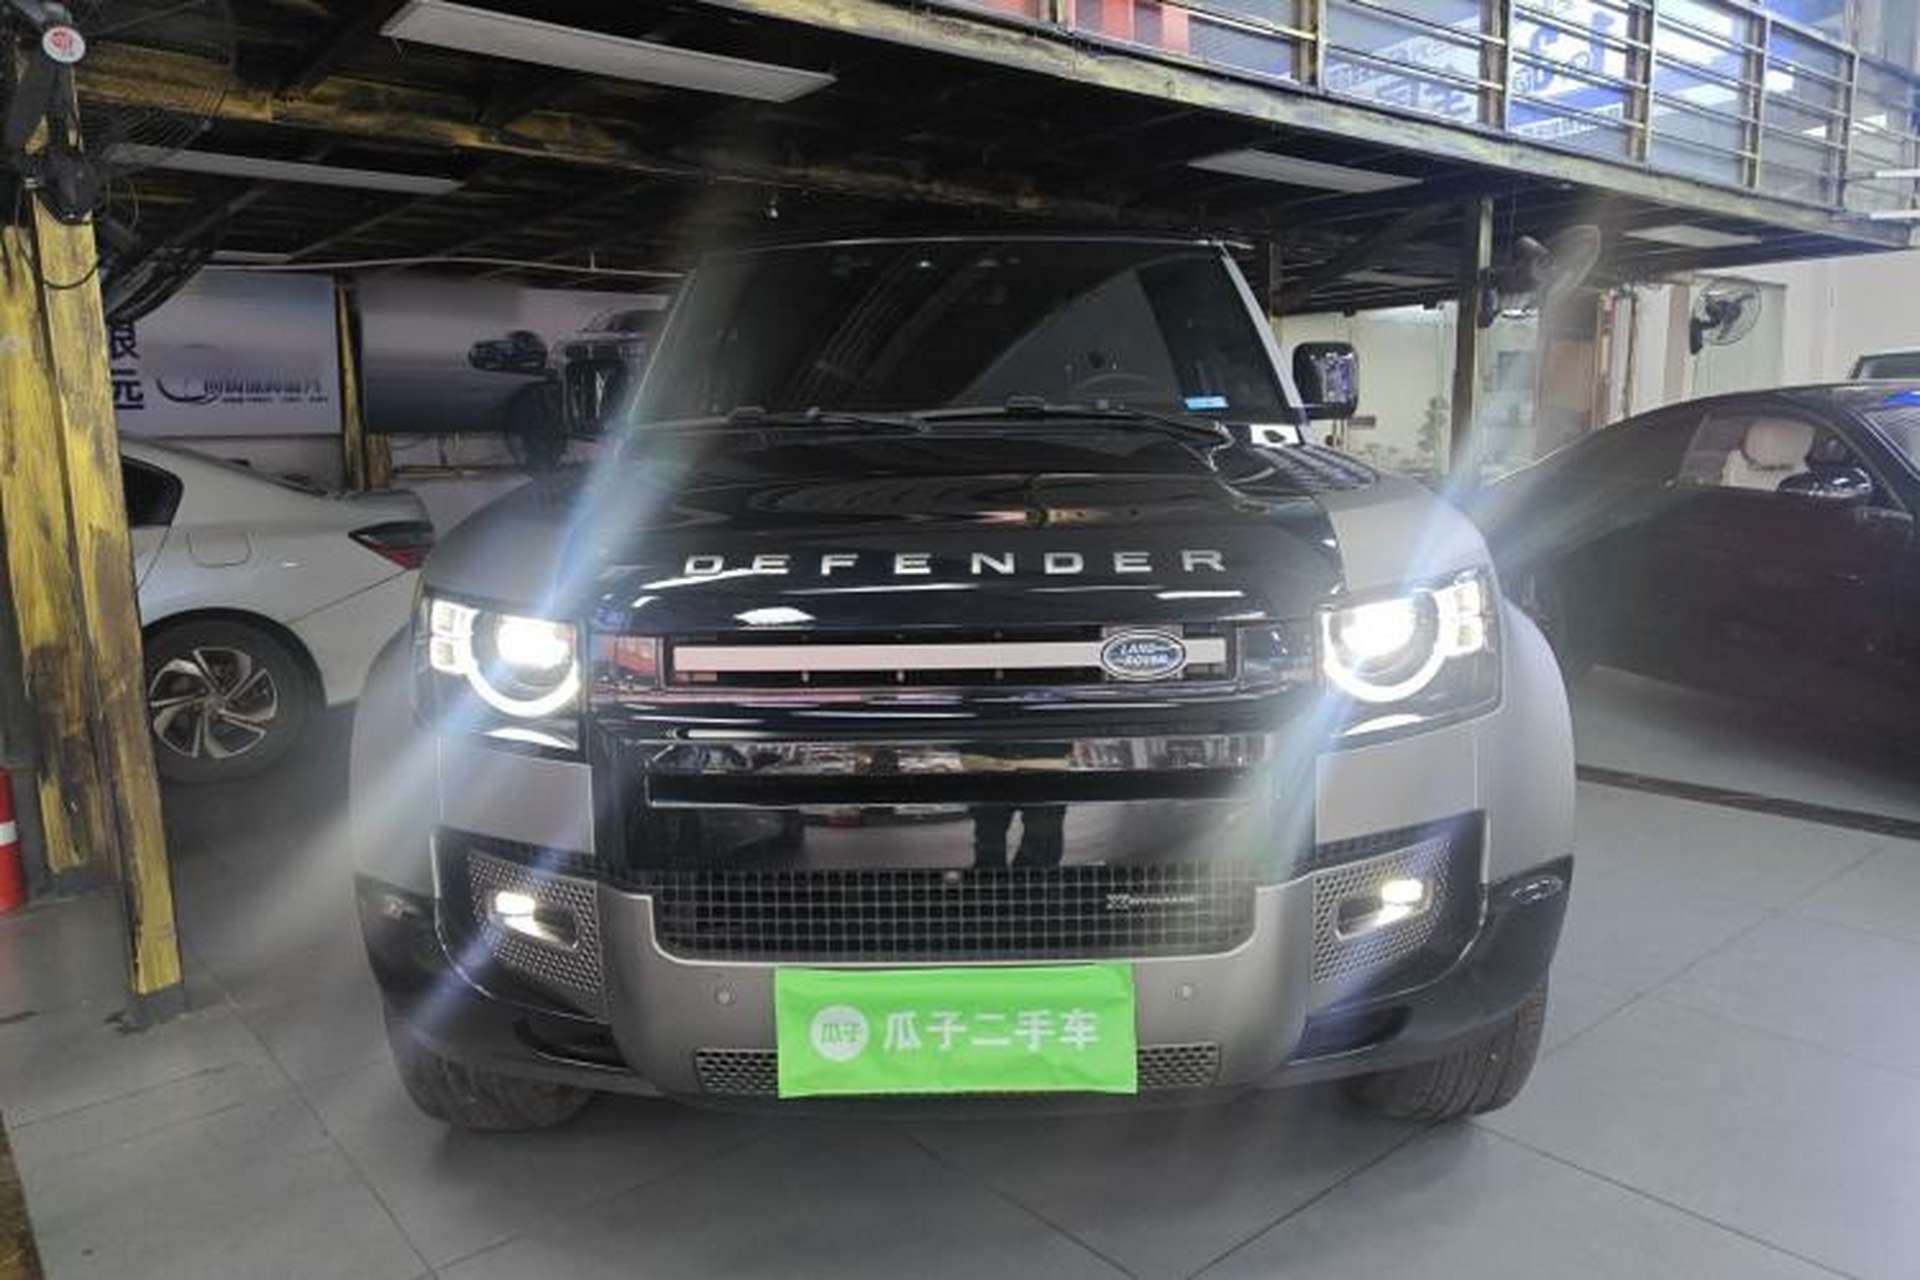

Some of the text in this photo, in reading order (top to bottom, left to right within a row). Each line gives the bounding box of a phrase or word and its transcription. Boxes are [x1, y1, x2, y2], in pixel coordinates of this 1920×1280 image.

[683, 550, 1227, 576] DEFENDER
[885, 1009, 1100, 1053] 瓜子二手车
